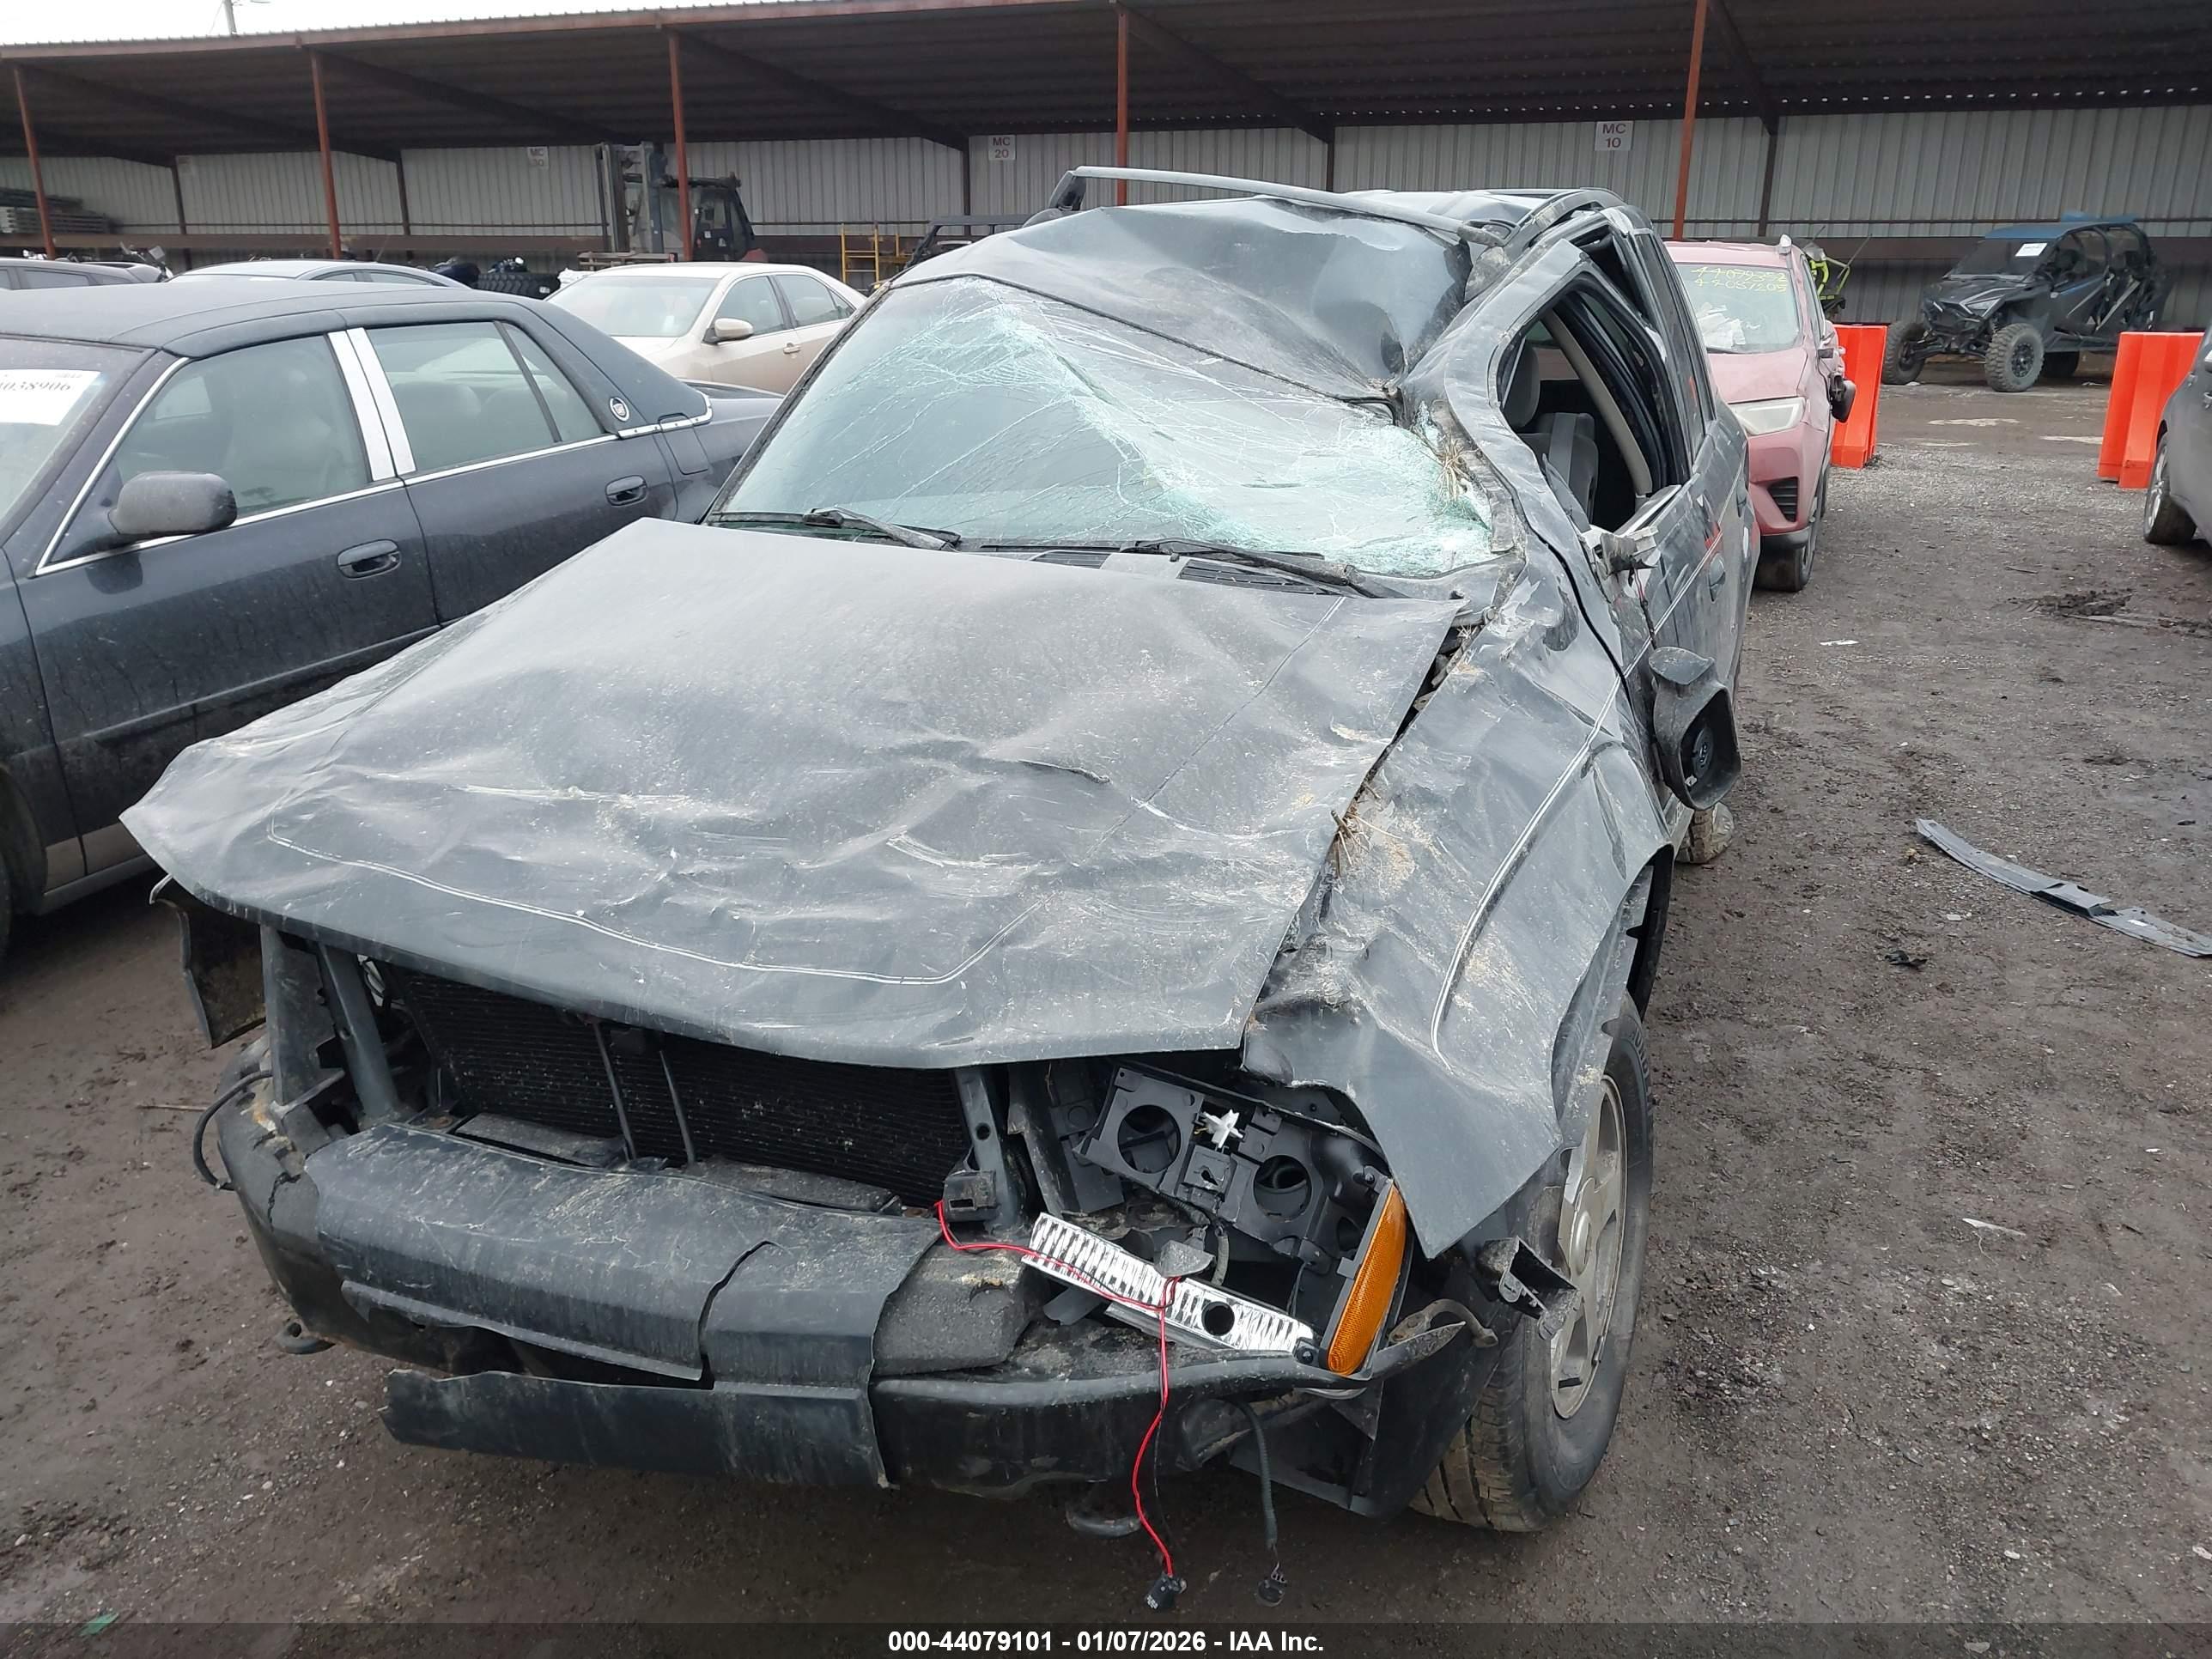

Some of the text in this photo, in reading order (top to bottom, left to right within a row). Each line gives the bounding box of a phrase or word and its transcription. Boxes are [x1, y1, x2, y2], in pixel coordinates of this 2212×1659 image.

[1602, 123, 1626, 134] MC
[993, 137, 1011, 146] MC
[1605, 137, 1622, 149] 10
[994, 148, 1009, 159] 20
